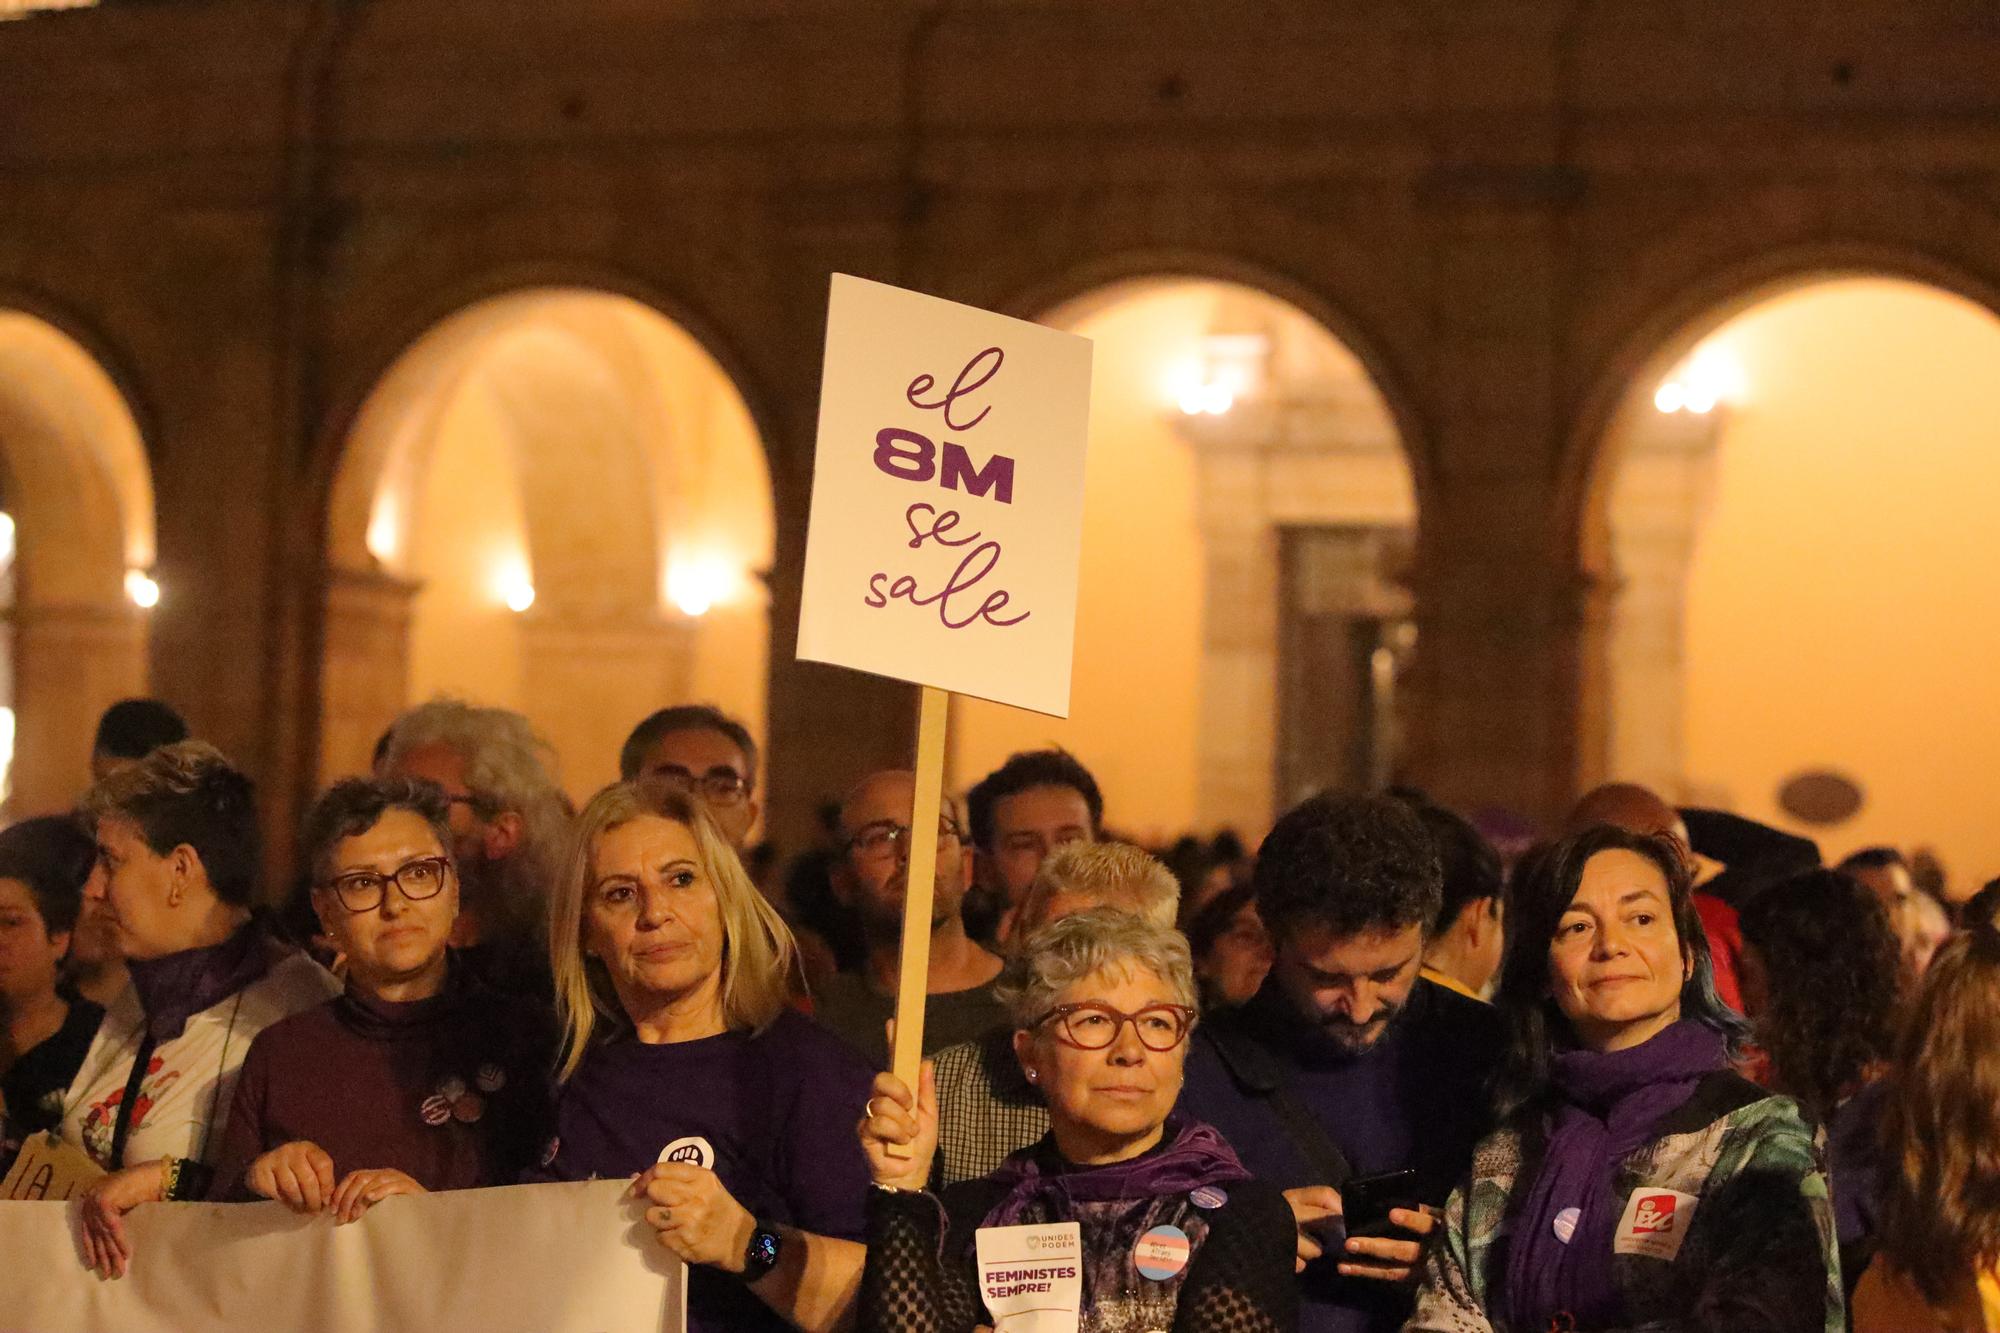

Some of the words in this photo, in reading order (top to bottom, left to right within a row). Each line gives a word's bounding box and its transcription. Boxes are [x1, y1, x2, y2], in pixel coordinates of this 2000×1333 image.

[906, 346, 1005, 431] el
[873, 427, 1016, 504] 8M
[906, 502, 981, 549] se
[864, 541, 1031, 629] sale
[1041, 1233, 1075, 1242] UNIDES
[1041, 1241, 1075, 1249] PODEM
[985, 1266, 1076, 1284] FEMINISTES
[986, 1282, 1052, 1299] SEMPRE!
